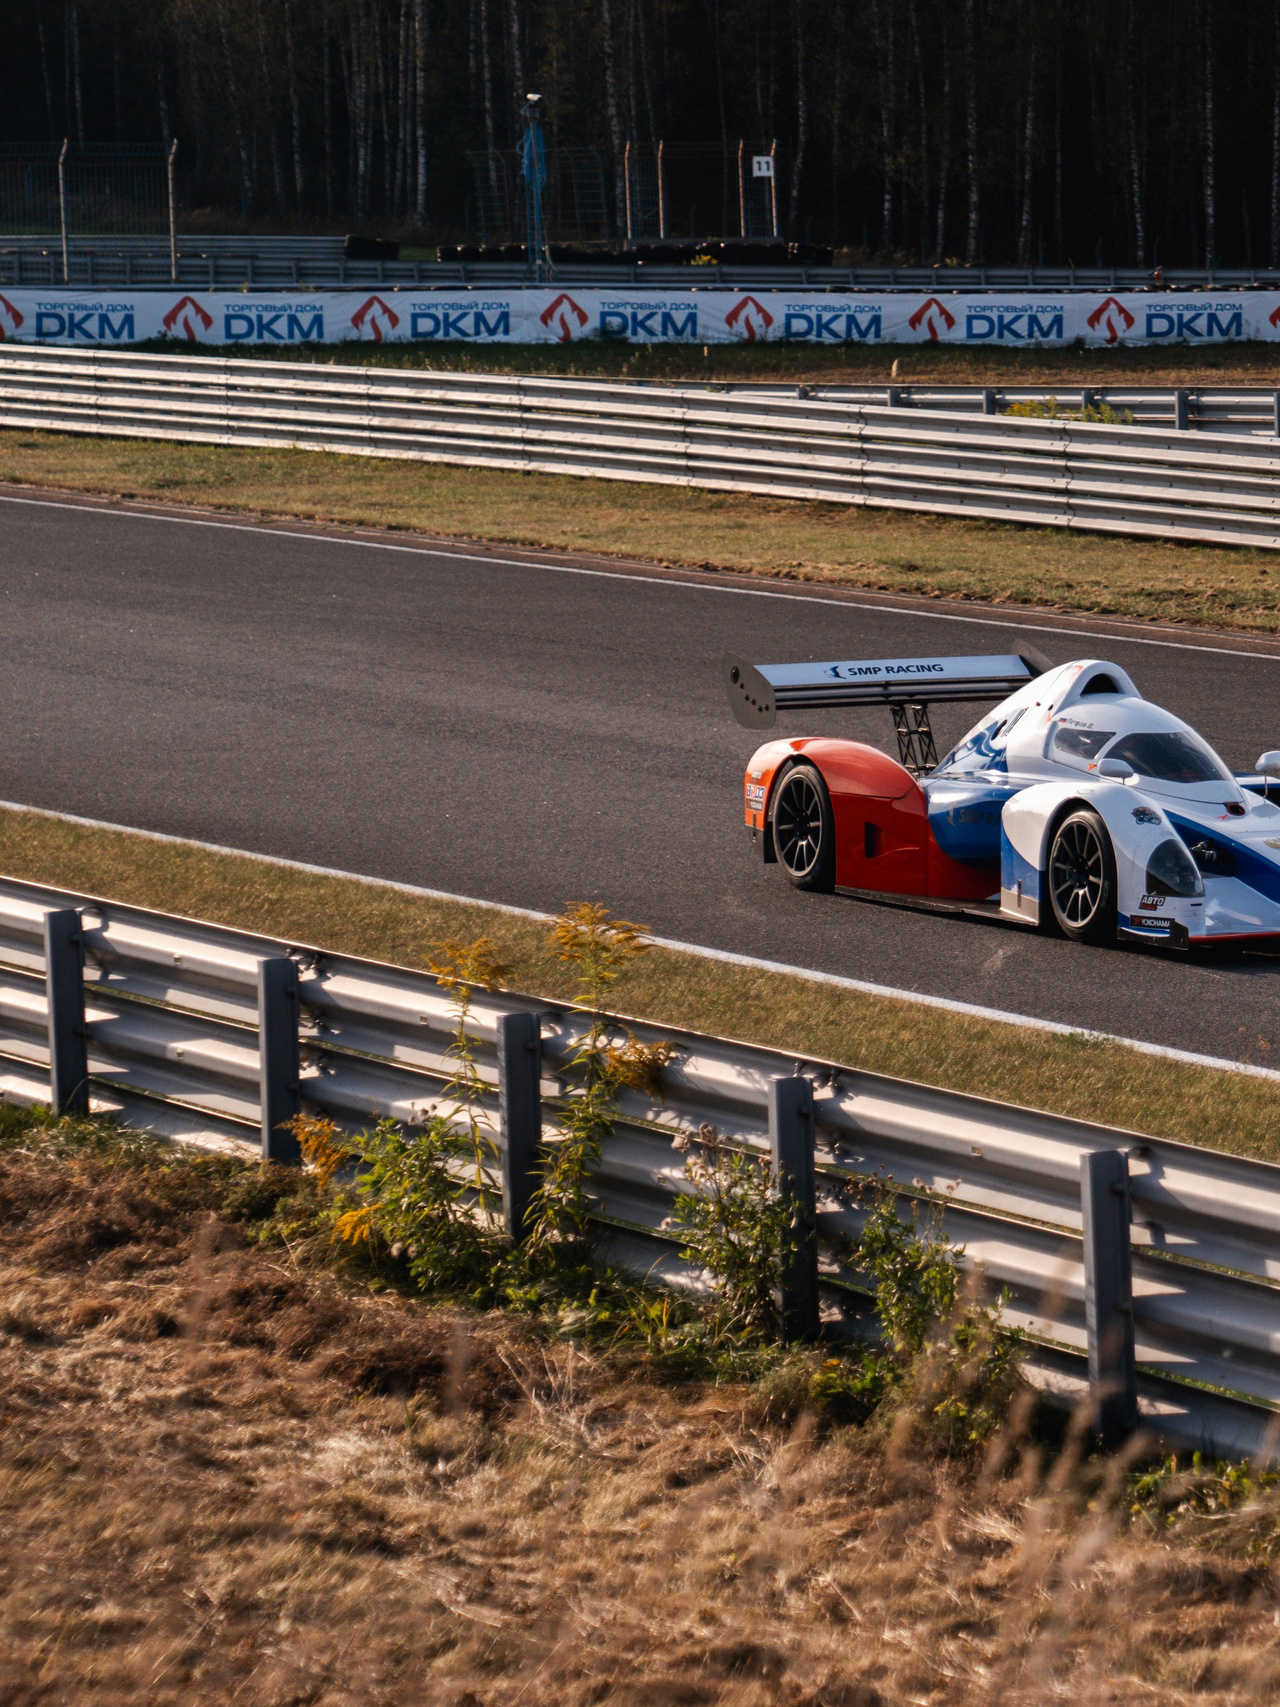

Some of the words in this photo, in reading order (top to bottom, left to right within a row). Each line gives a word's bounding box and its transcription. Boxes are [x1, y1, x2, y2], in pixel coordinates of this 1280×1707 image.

[756, 160, 770, 172] 11
[36, 302, 102, 312] ТОРГОВЫЙ
[106, 302, 134, 313] ДОМ
[224, 303, 292, 312] ТОРГОВЫЙ
[294, 303, 323, 314] ДОМ
[411, 302, 478, 310] ТОРГОВЫЙ
[482, 302, 510, 312] ДОМ
[600, 301, 668, 310] ТОРГОВЫЙ
[670, 301, 698, 311] ДОМ
[786, 304, 850, 313] ТОРГОВЫЙ
[853, 304, 882, 314] ДОМ
[966, 304, 1032, 313] ТОРГОВЫЙ
[1034, 304, 1064, 314] ДОМ
[1146, 303, 1212, 312] ТОРГОВЫЙ
[1214, 303, 1242, 313] ДОМ
[35, 312, 134, 340] DKM
[224, 314, 323, 340] DKM
[411, 311, 510, 338] DKM
[600, 311, 697, 337] DKM
[784, 313, 881, 339] DKM
[966, 314, 1063, 339] DKM
[1145, 312, 1242, 337] DKM
[848, 666, 881, 676] SMP
[885, 664, 944, 674] RACING
[1142, 896, 1164, 905] АВТО
